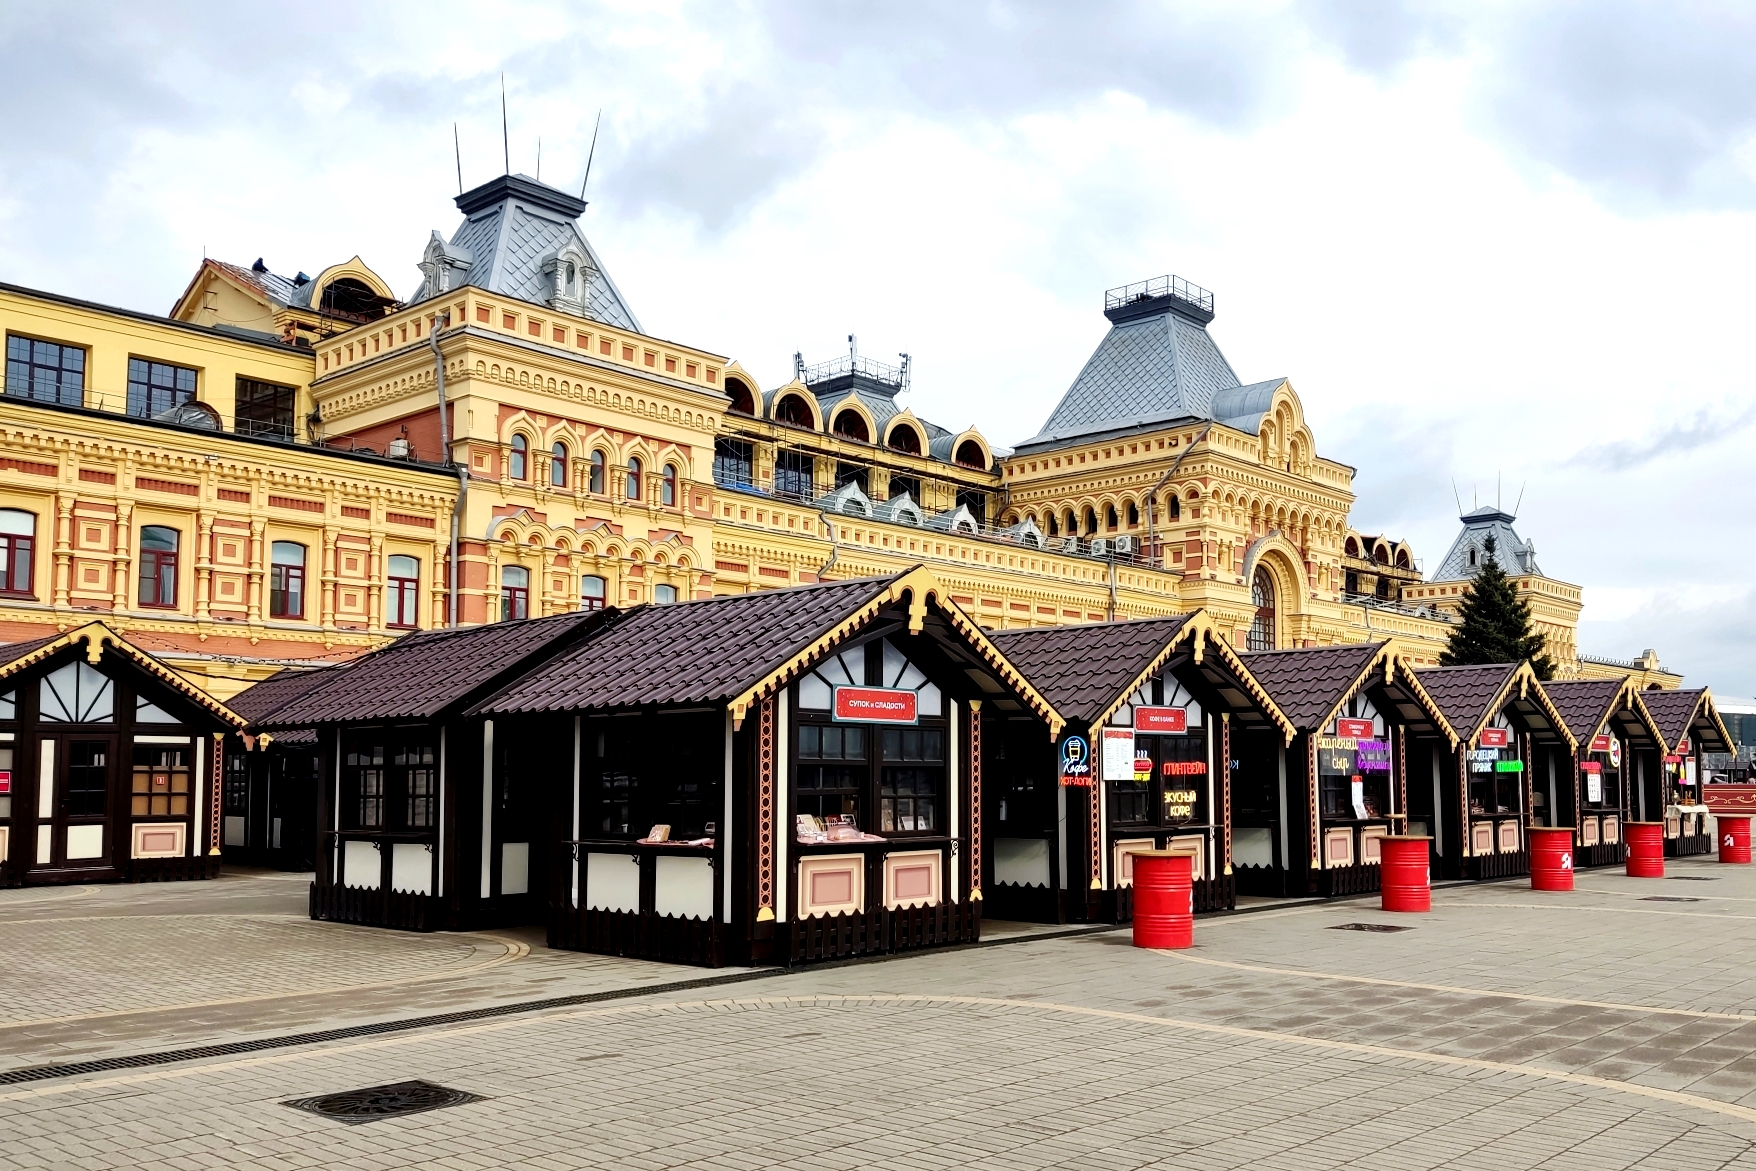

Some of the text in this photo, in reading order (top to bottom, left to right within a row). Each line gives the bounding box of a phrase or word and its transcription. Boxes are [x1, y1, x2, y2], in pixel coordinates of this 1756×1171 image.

[875, 702, 906, 710] СЛАДОСТИ
[1467, 748, 1498, 762] ГОРОДЕЦКИЙ
[1063, 758, 1089, 776] Кофе
[1164, 761, 1206, 775] ГЛИНТВЕЙН
[1472, 762, 1492, 773] ПРЯНИК
